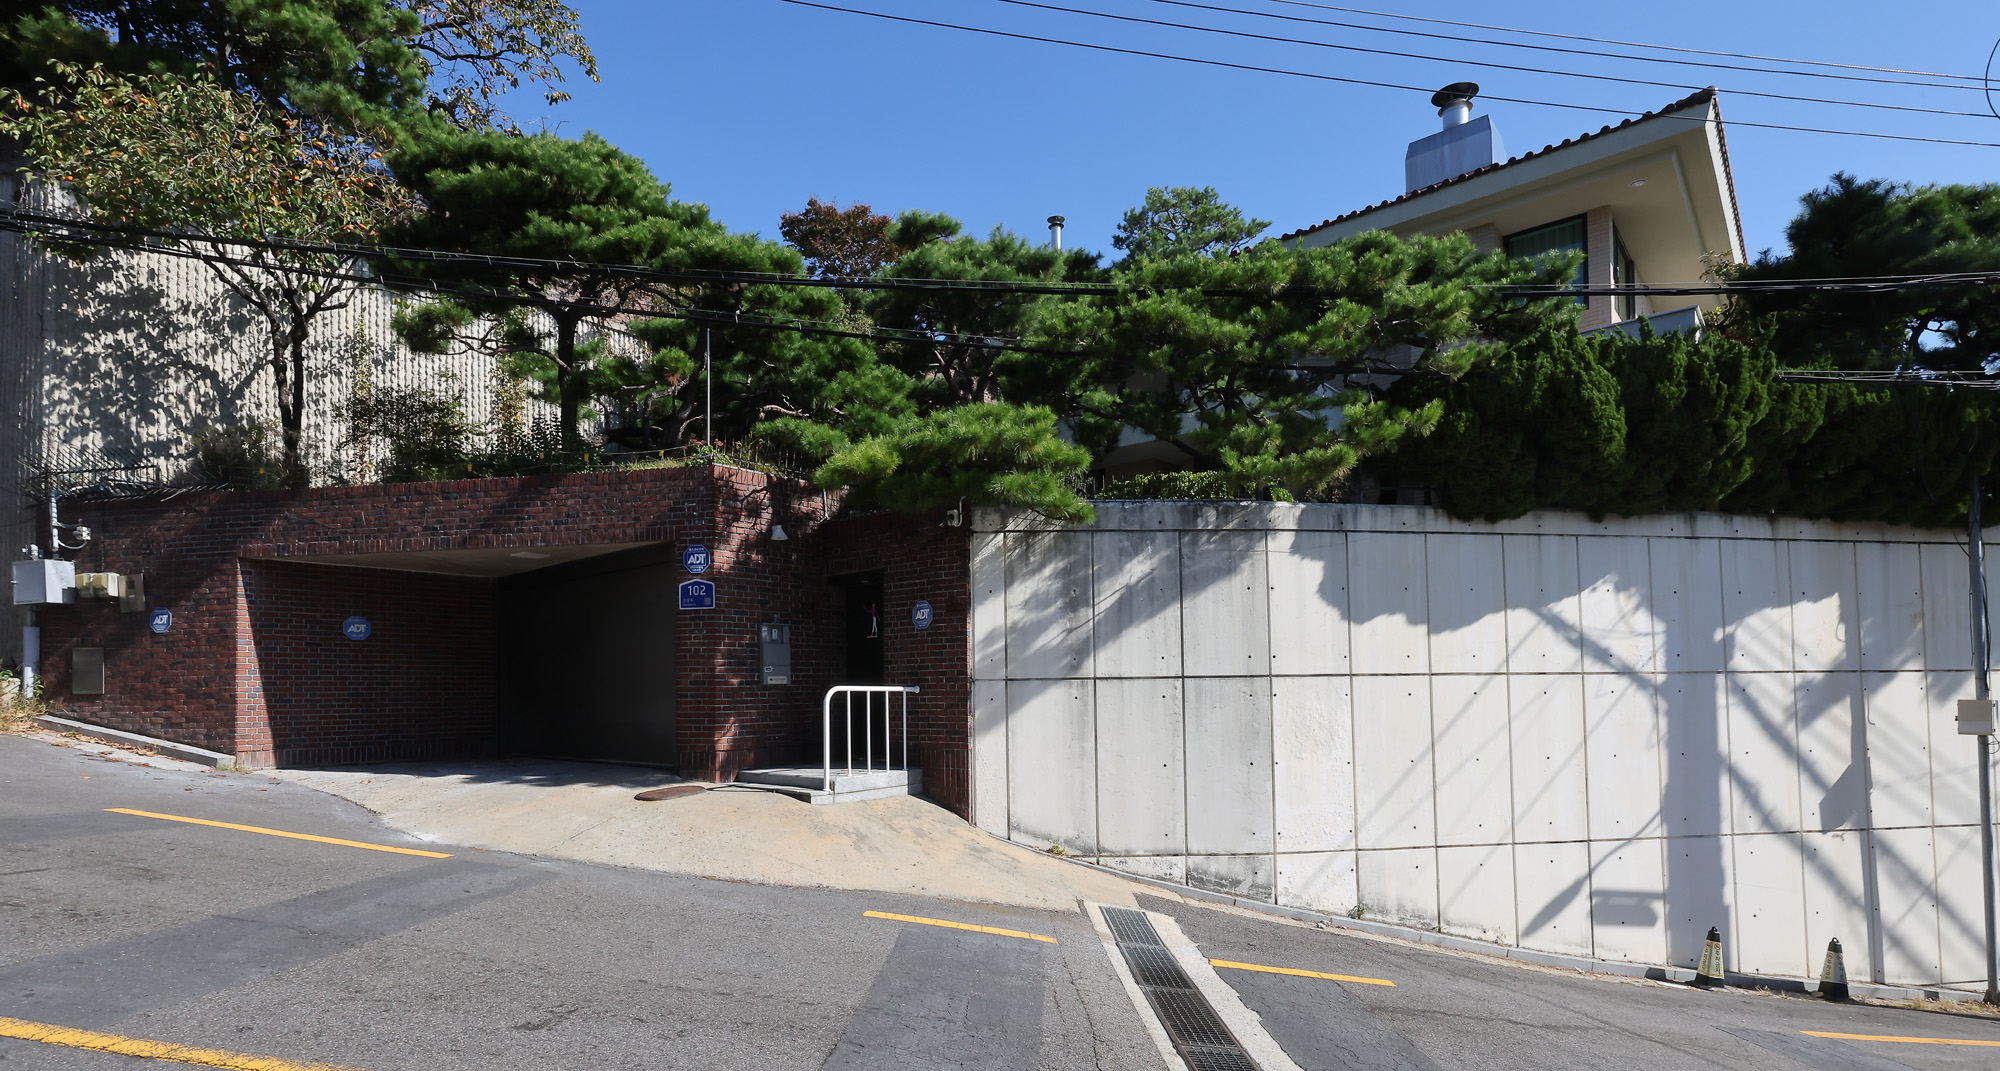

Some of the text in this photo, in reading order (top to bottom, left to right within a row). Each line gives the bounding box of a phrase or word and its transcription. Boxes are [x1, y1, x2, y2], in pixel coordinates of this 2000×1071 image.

[688, 554, 706, 564] ADT
[688, 585, 706, 595] 102
[915, 609, 930, 619] ADT
[153, 615, 168, 624] ADT
[347, 624, 366, 632] ADT
